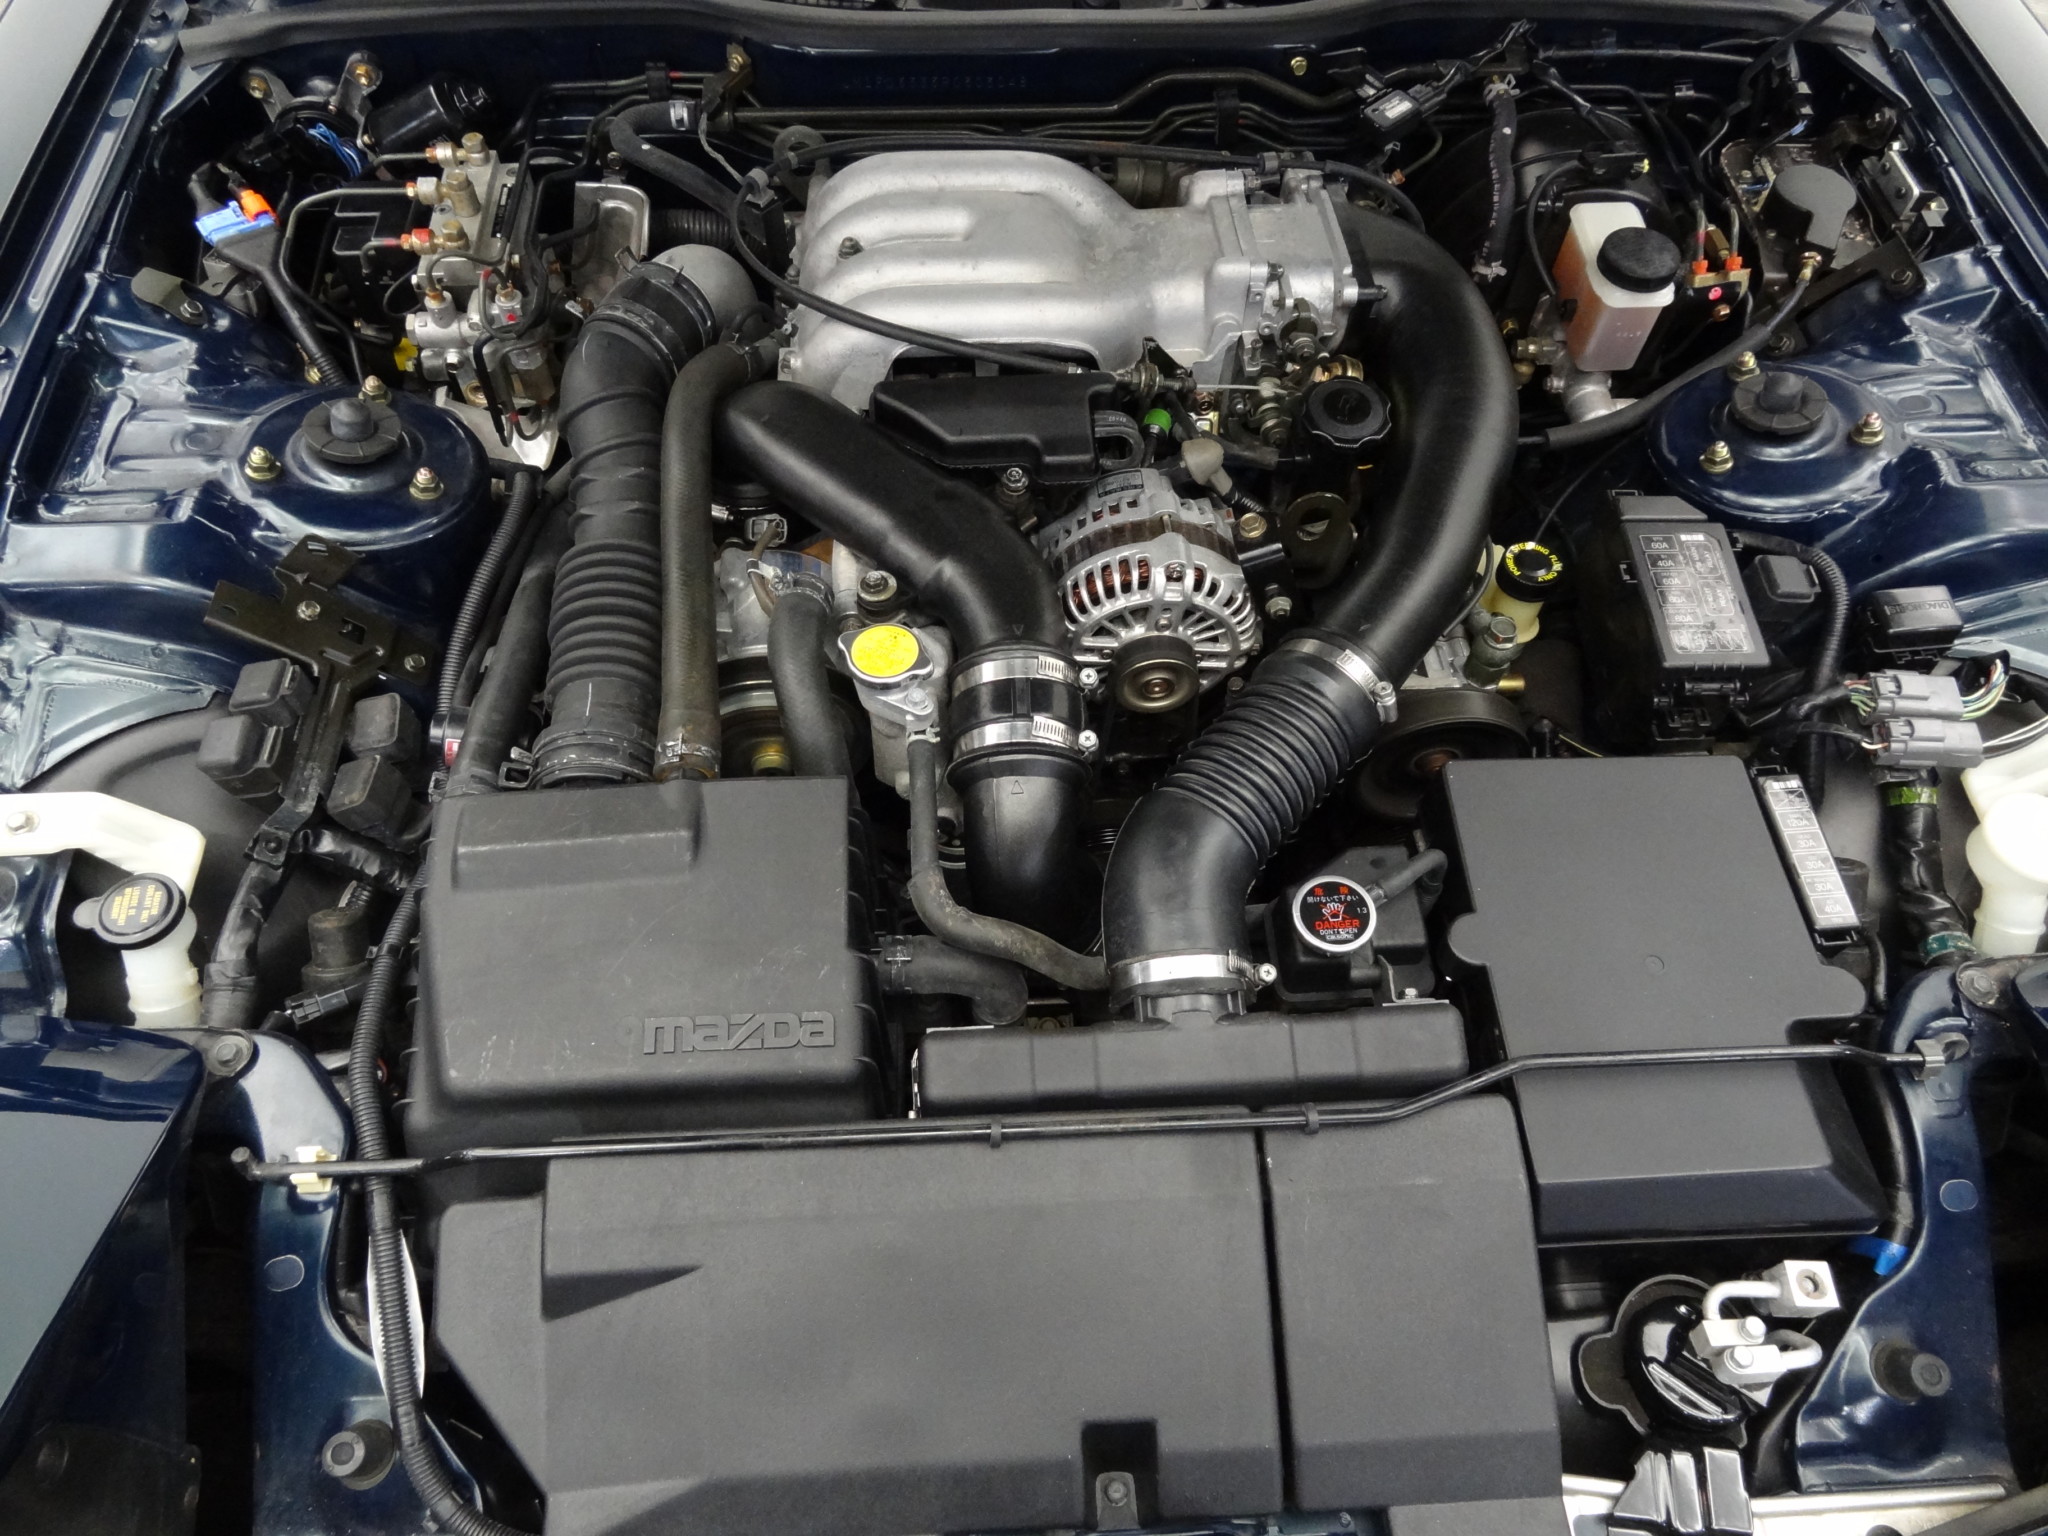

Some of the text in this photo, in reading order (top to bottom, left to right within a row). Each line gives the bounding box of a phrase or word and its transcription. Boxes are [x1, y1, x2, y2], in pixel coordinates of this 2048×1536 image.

[1511, 541, 1549, 555] STEEING
[1651, 541, 1669, 549] 60A
[1506, 553, 1521, 576] POWER
[1657, 559, 1674, 567] 40A
[1538, 571, 1557, 582] ONLY
[1662, 577, 1681, 585] 60A
[1888, 601, 1949, 615] DIAGNOSIS
[1786, 818, 1810, 827] 120A
[1796, 839, 1817, 848] 30A
[1805, 860, 1825, 869] 30A
[1814, 882, 1834, 892] 30A
[140, 884, 156, 923] COOLANT ONLY
[1824, 904, 1844, 913] 40A
[1314, 919, 1360, 930] DANGER
